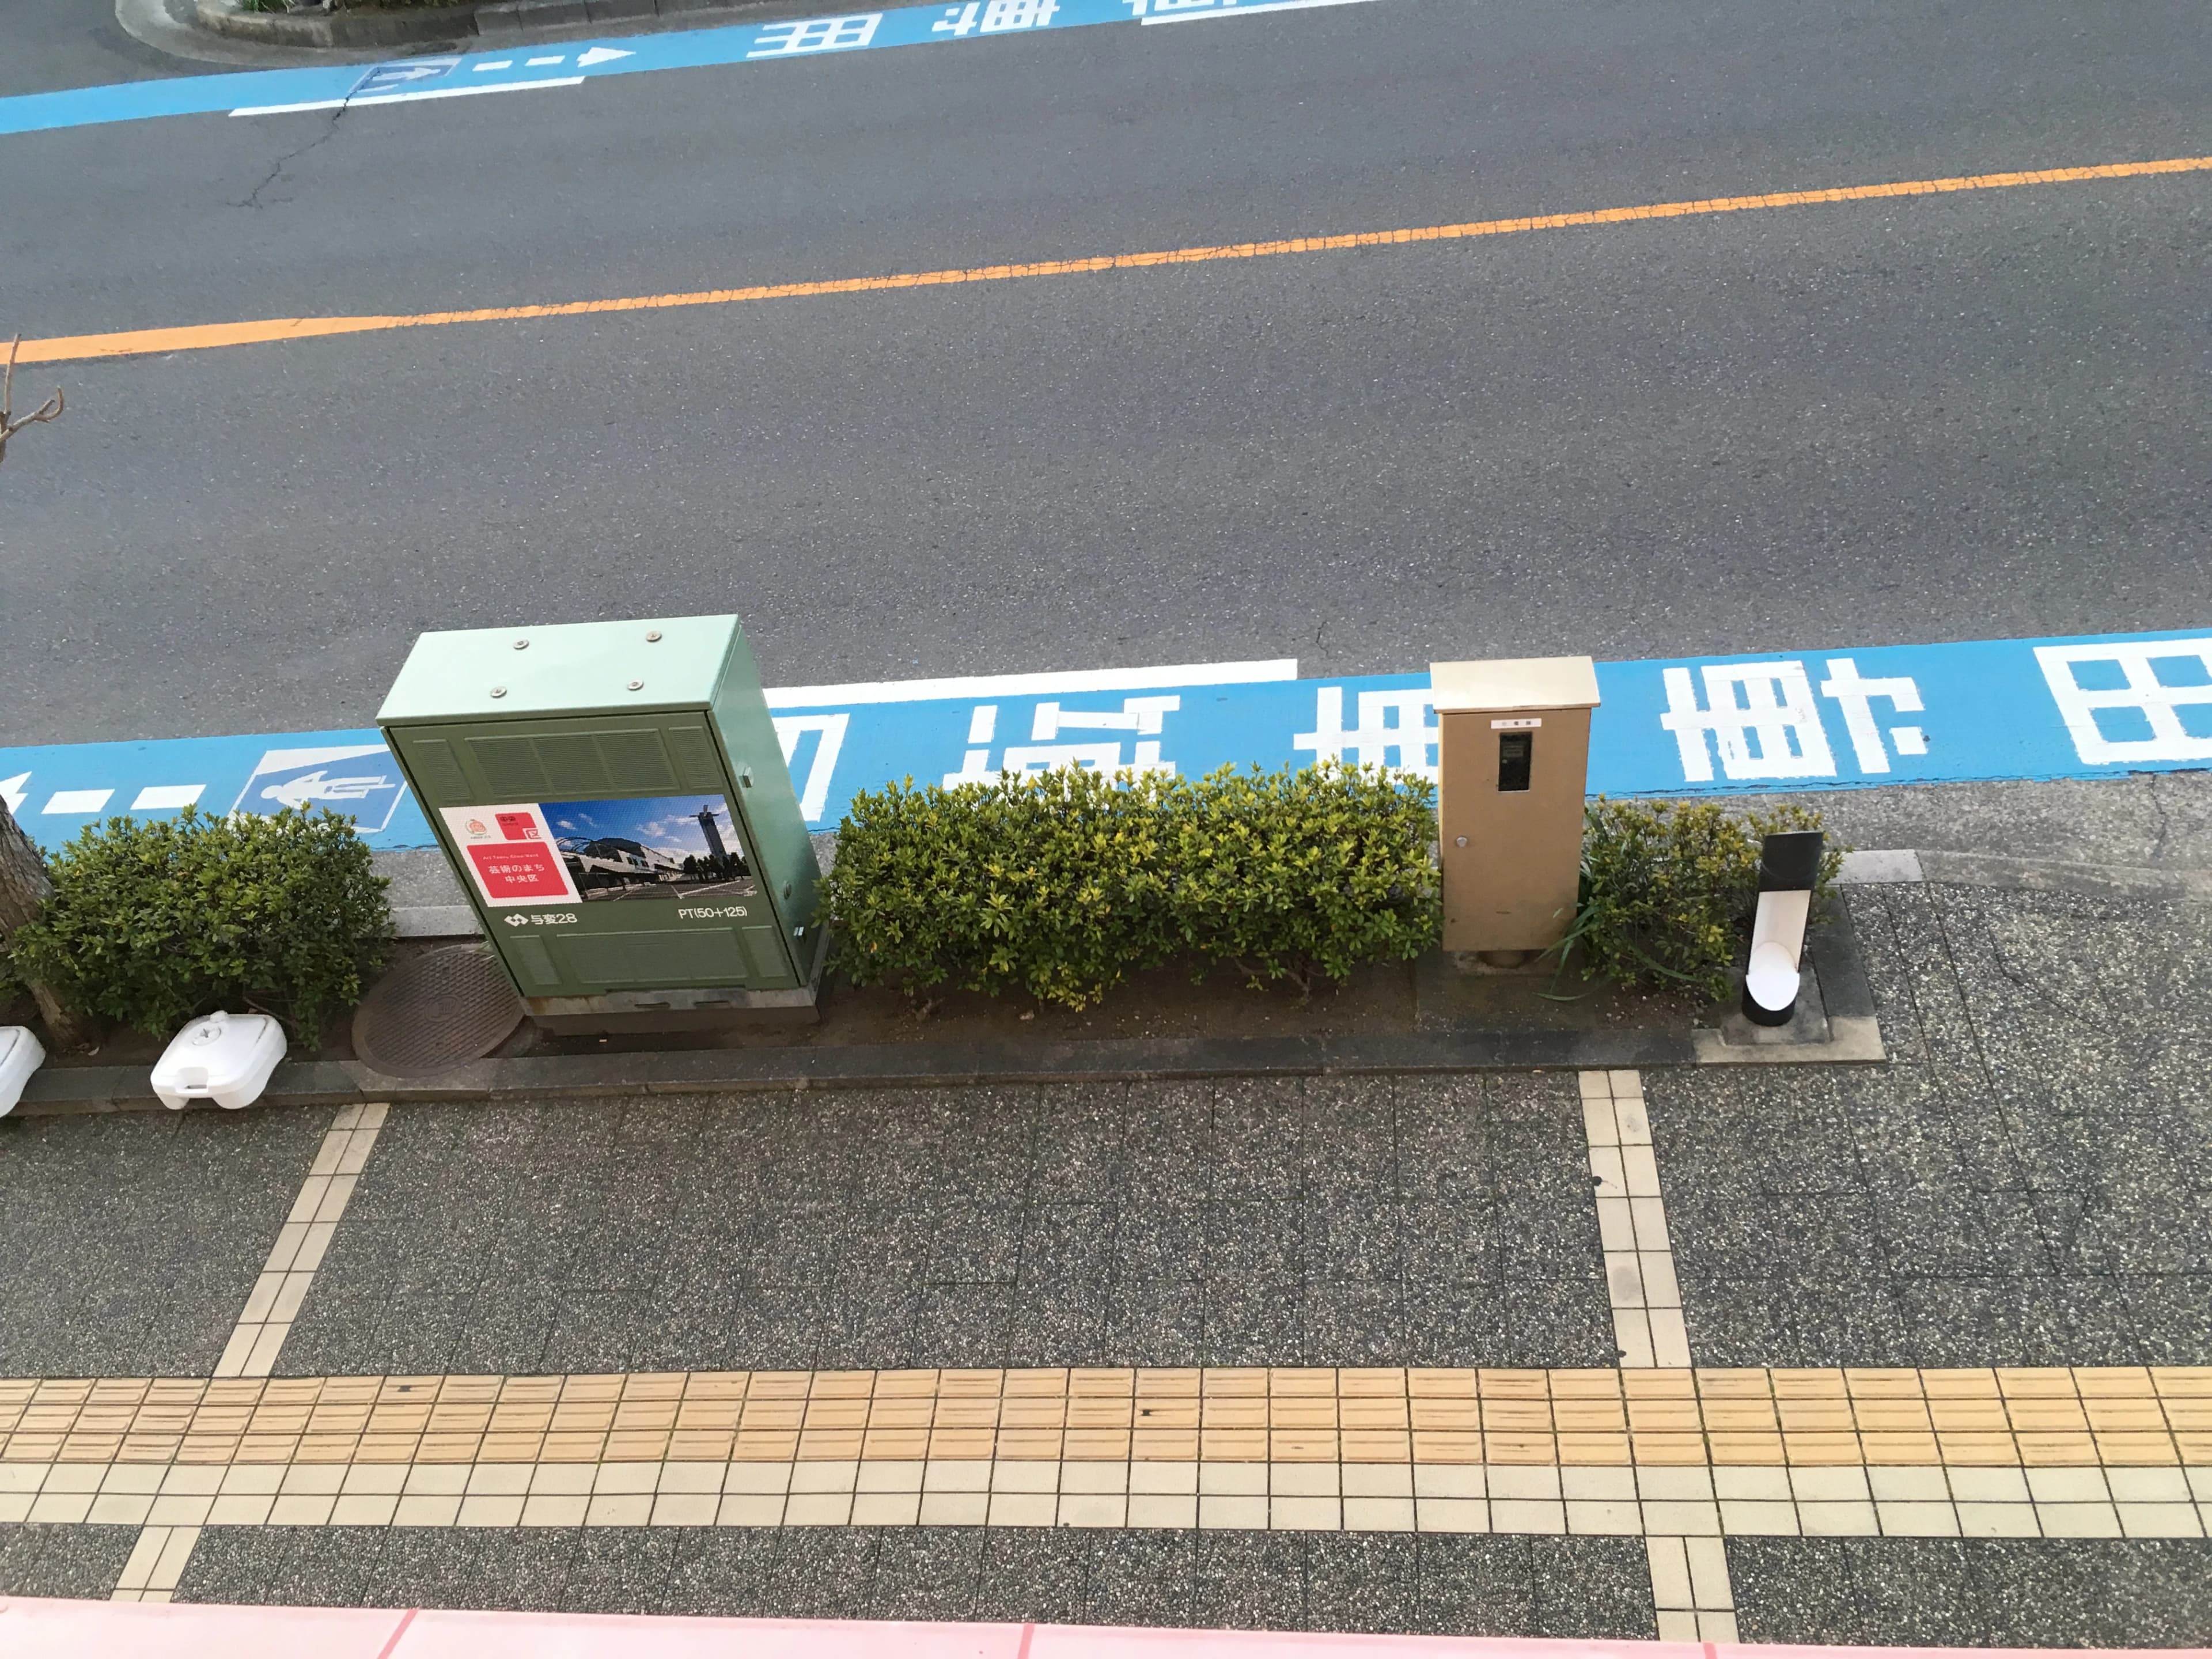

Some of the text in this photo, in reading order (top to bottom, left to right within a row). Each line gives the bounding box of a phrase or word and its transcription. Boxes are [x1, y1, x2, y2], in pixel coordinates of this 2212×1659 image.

[488, 864, 544, 874] 芸術のまち
[505, 874, 539, 884] 中央区
[678, 906, 748, 919] PT(50+125)
